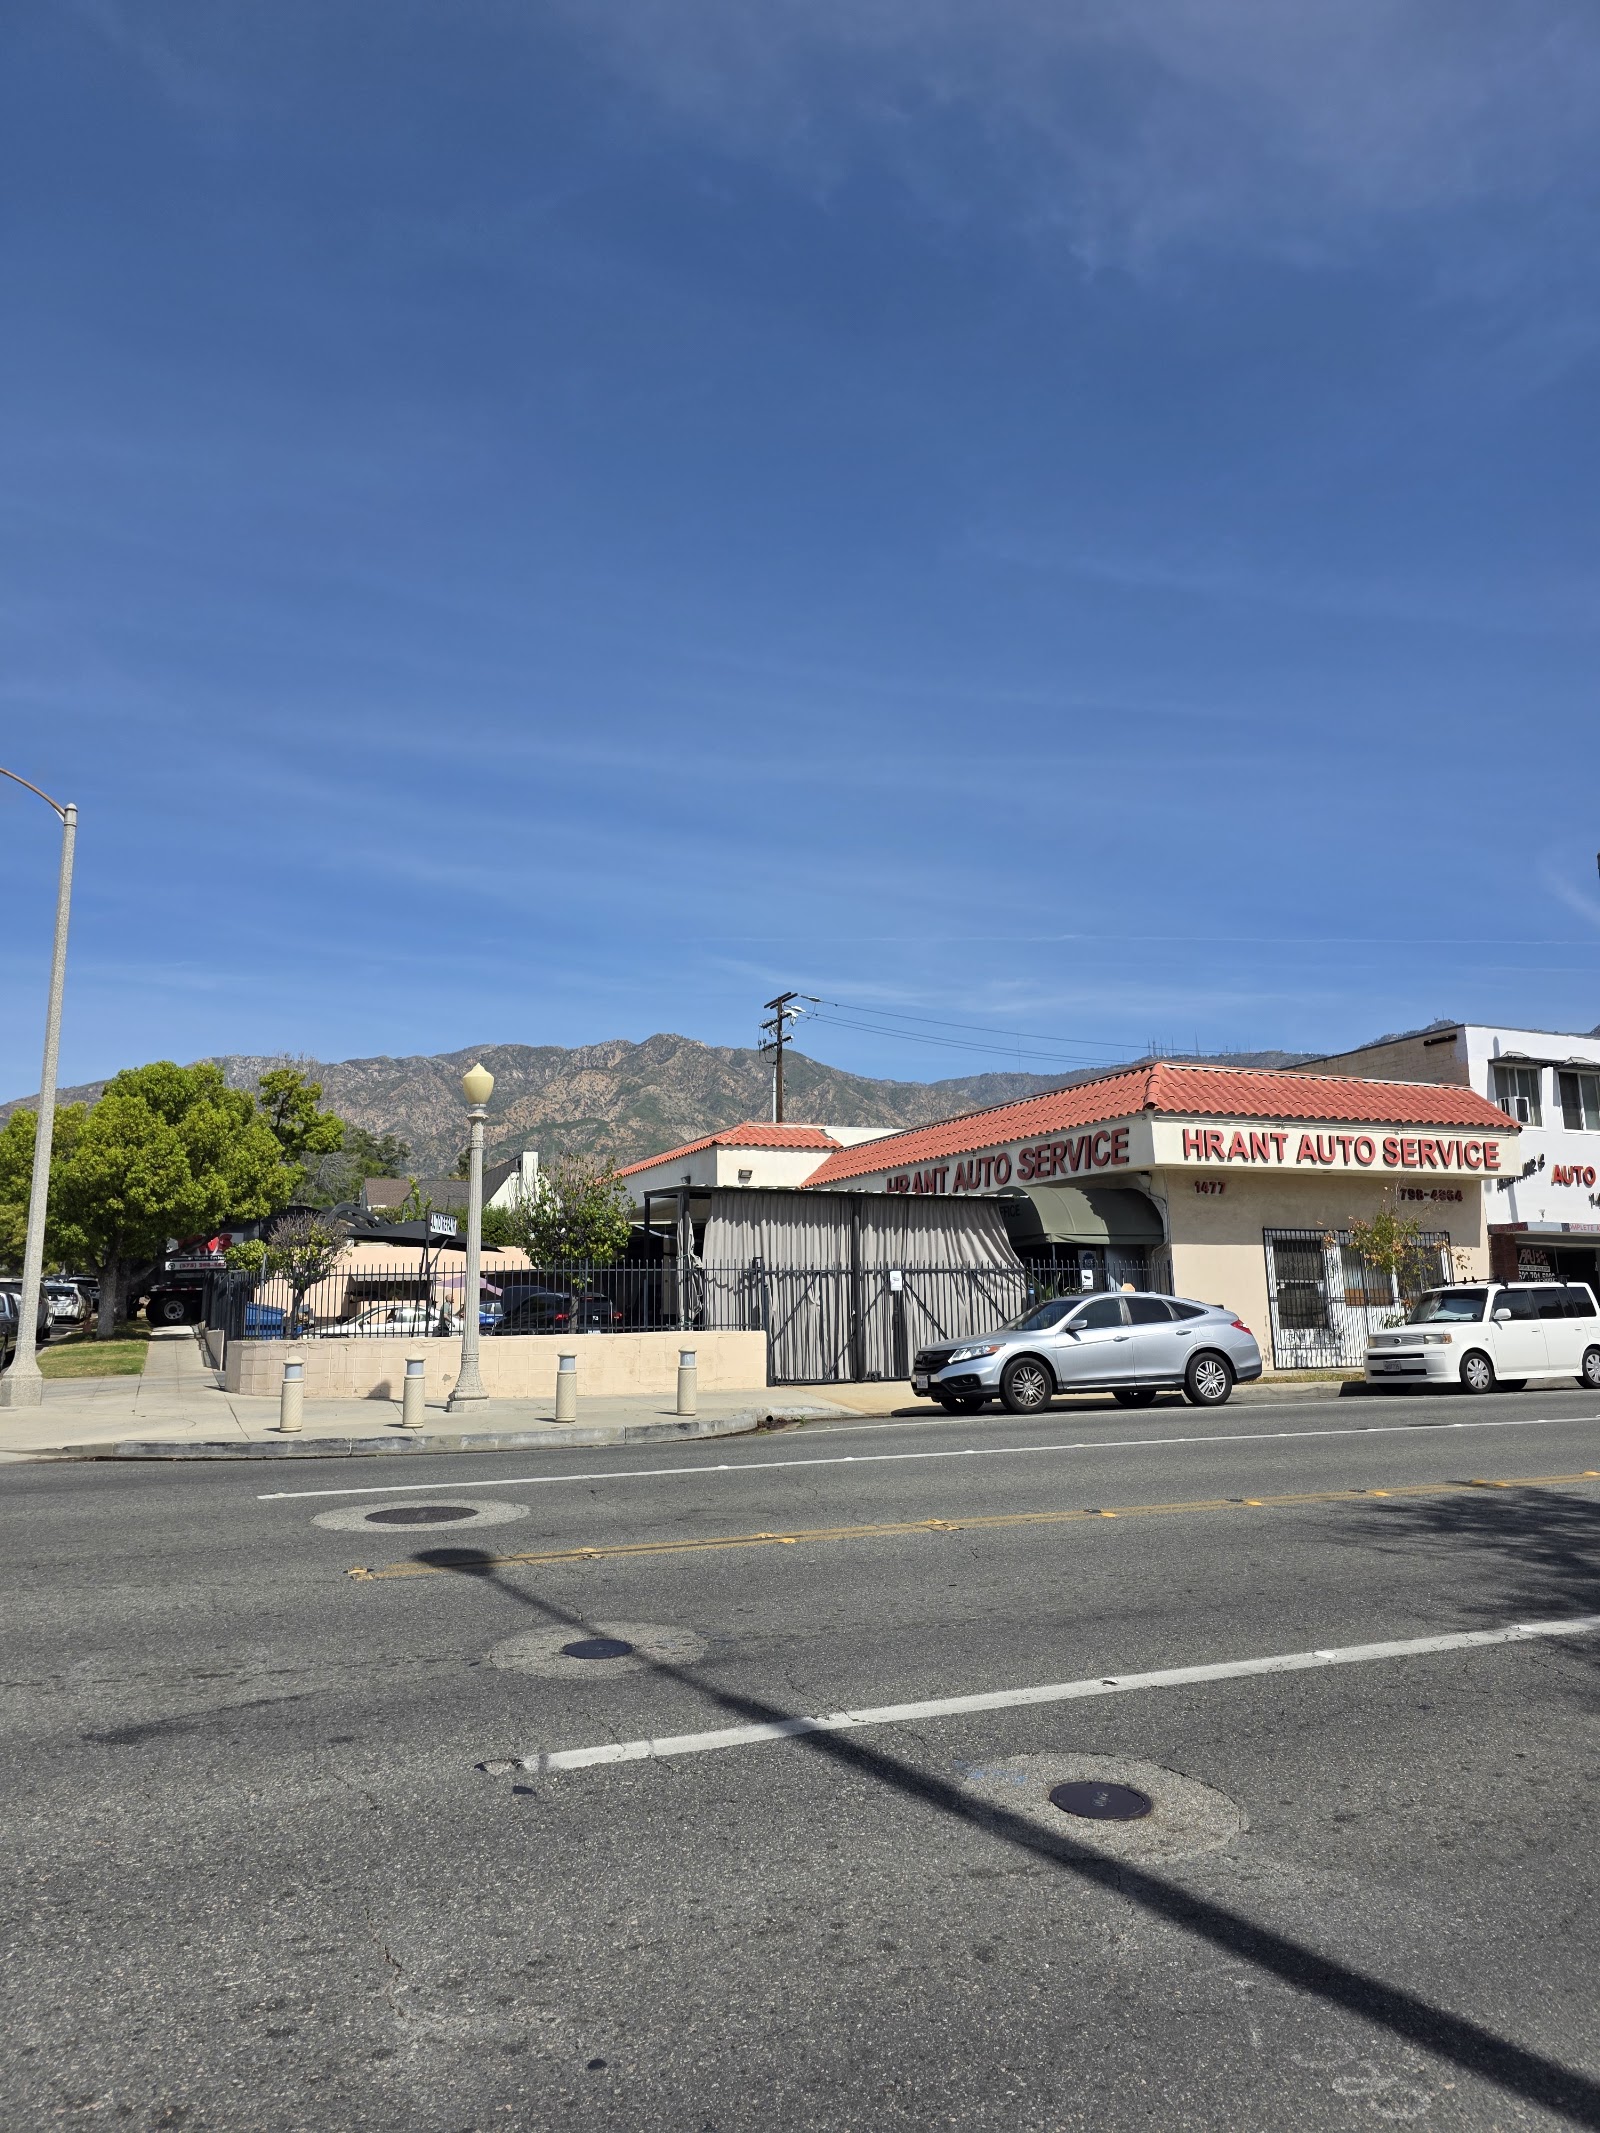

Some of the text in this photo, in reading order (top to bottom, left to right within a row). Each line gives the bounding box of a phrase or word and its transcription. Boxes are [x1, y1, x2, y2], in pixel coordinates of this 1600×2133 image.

[1183, 1128, 1501, 1168] HRANT AUTO SERVICE
[887, 1127, 1129, 1193] HRANT AUTO SERVICE
[1552, 1165, 1596, 1186] AUTO
[1195, 1181, 1225, 1194] 1477
[999, 1204, 1021, 1217] FFICE
